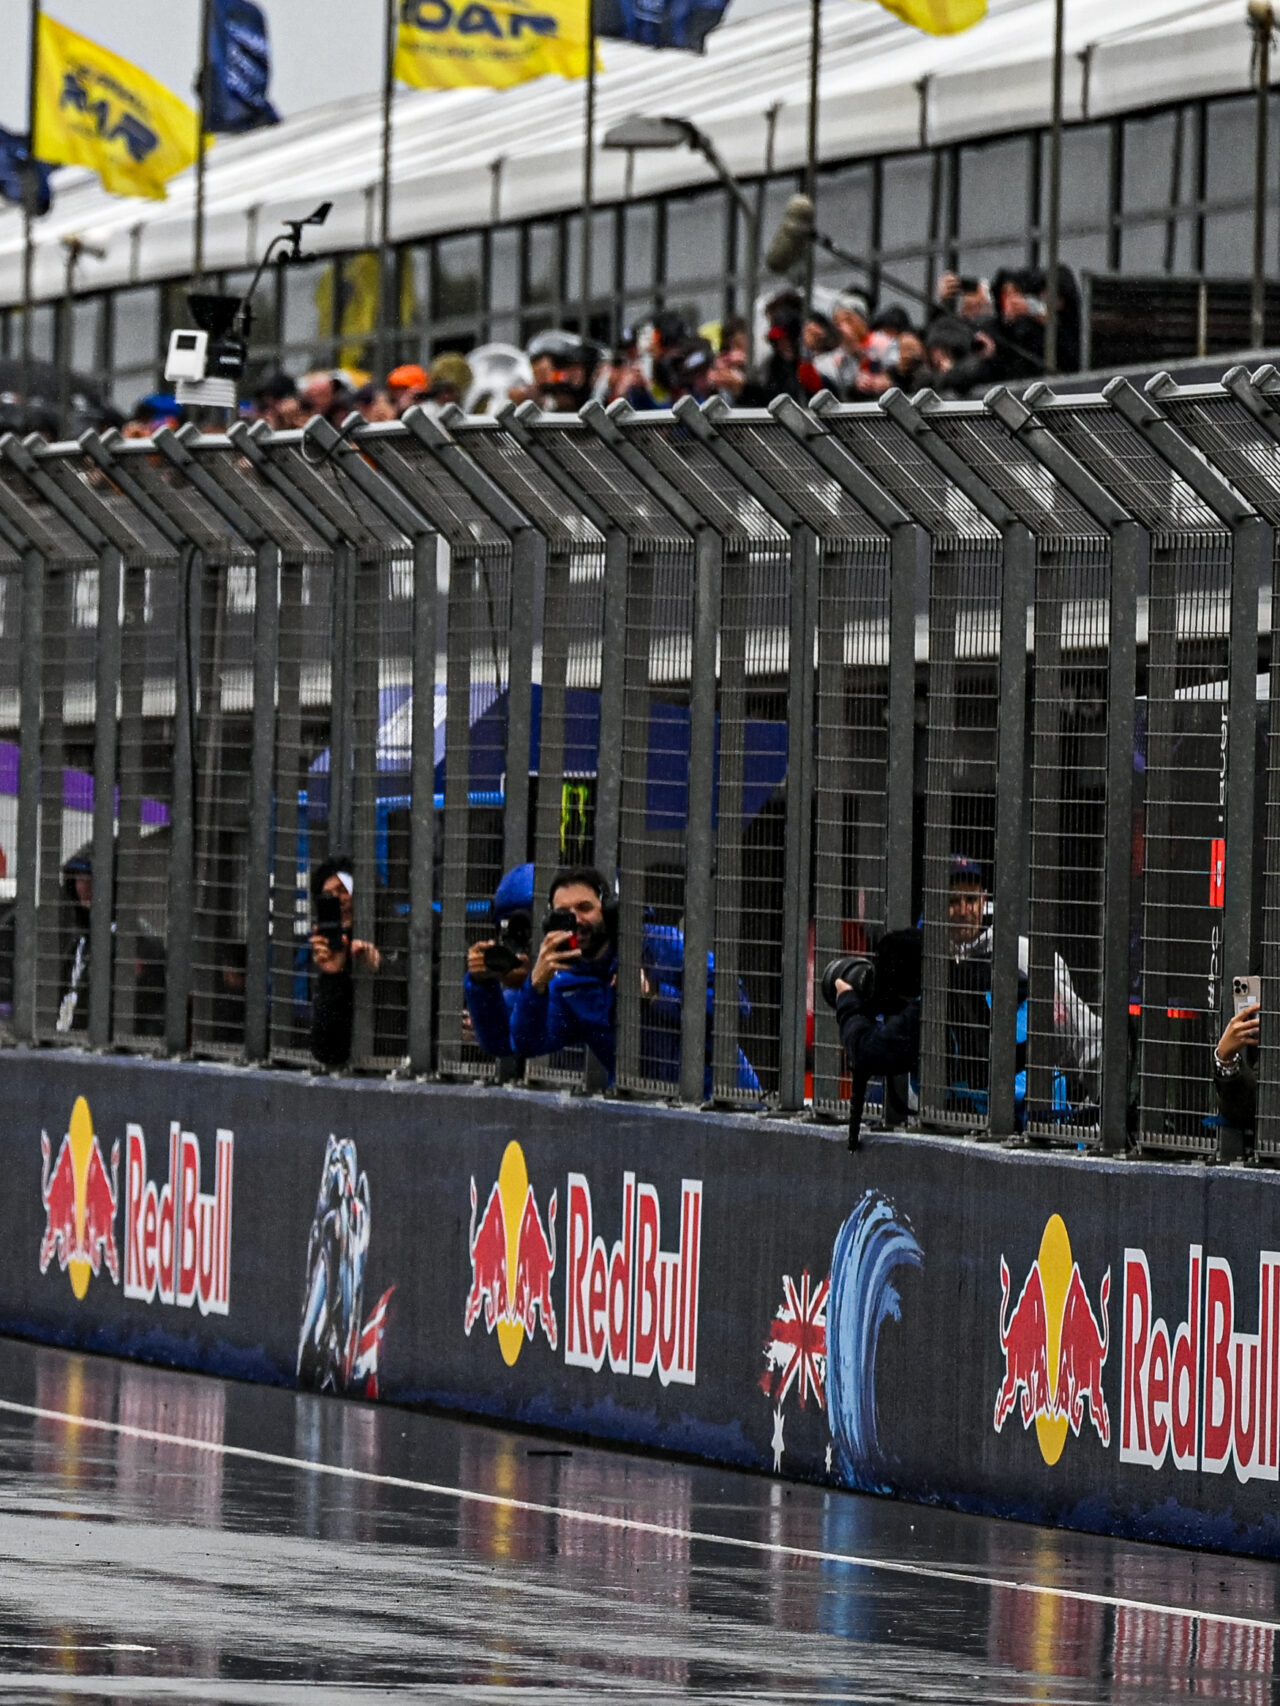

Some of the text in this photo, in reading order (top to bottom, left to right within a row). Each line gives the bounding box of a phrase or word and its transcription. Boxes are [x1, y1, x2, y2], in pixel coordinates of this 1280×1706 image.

[124, 1121, 233, 1316] Red Bull
[565, 1171, 702, 1386] Red Bull
[1119, 1244, 1279, 1484] Red Bull
